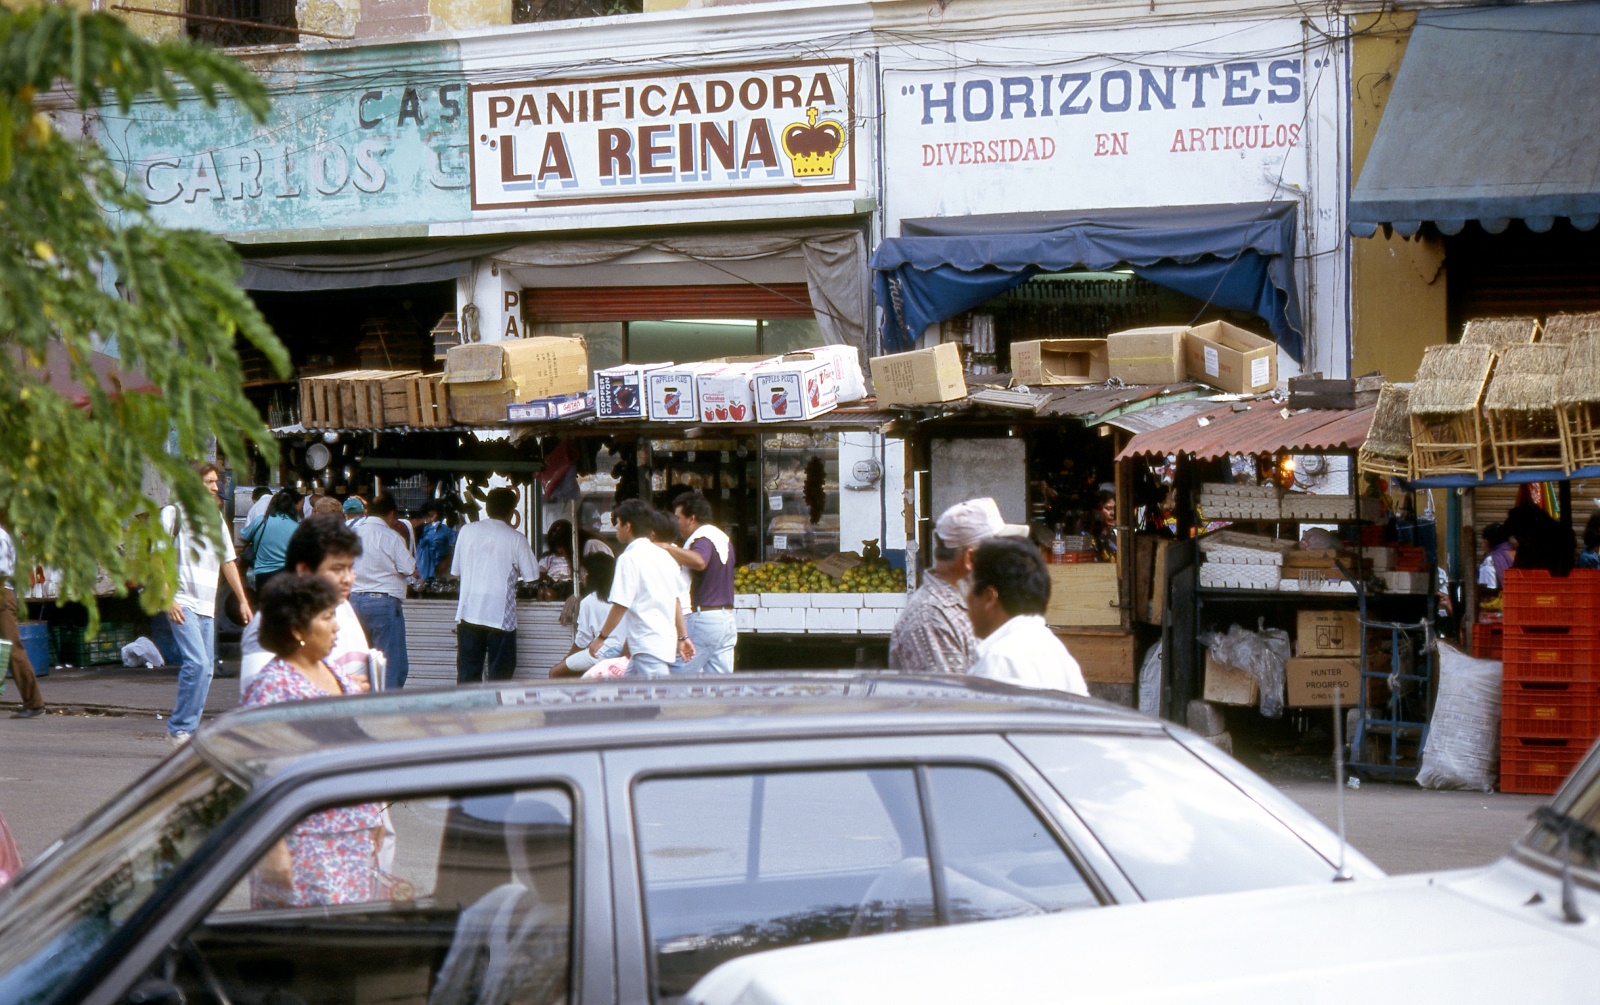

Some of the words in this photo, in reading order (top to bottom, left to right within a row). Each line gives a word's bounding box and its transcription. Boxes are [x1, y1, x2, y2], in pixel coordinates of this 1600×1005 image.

[487, 72, 837, 128] PANIFICADORA
[598, 118, 784, 185] REINA
[922, 136, 1056, 167] DIVERSIDAD
[1094, 132, 1130, 156] EN
[1170, 123, 1302, 153] ARTICULOS
[141, 140, 388, 205] CARLOS
[599, 377, 607, 414] COPPER
[605, 377, 613, 414] CANYON
[655, 375, 674, 385] APPLES
[674, 375, 688, 384] PLUS
[761, 375, 781, 386] APPLES
[781, 374, 794, 384] PLUS
[1305, 680, 1350, 689] PROGRESO
[1310, 668, 1342, 677] HUNTER
